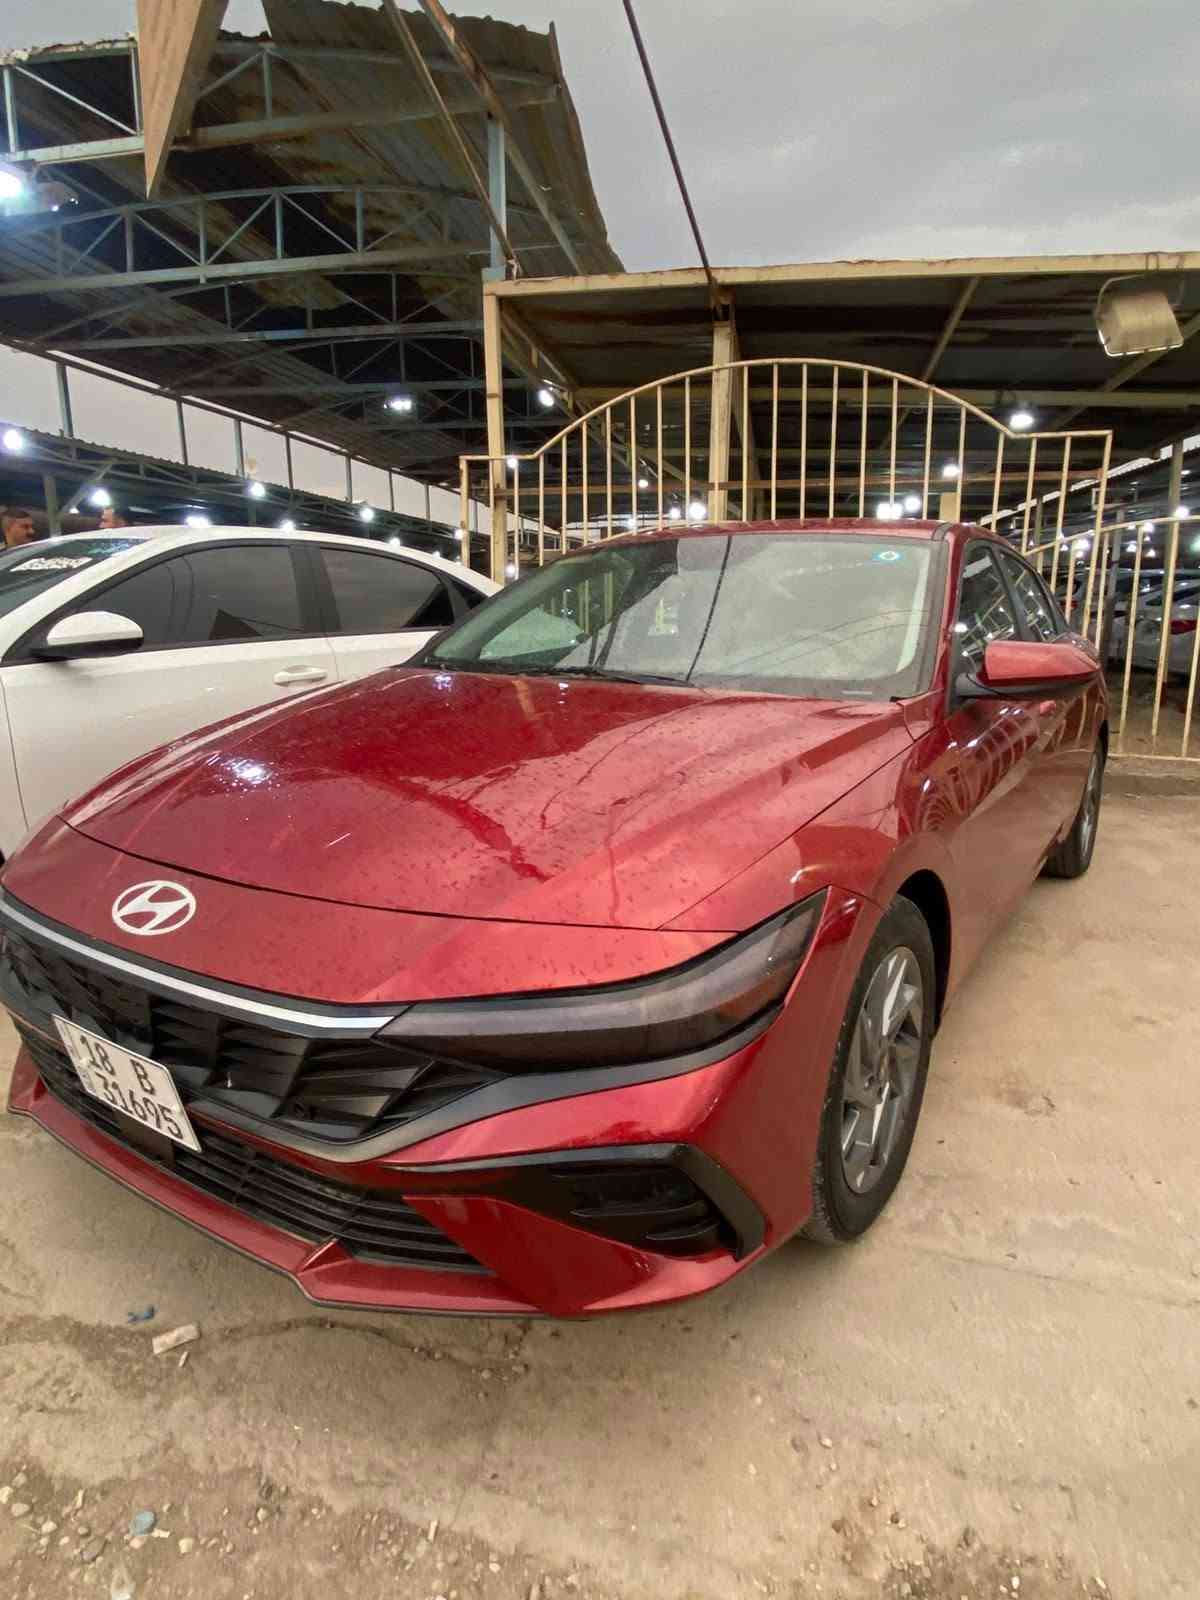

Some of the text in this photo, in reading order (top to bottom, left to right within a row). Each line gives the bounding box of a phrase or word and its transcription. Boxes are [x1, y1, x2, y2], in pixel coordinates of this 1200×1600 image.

[80, 1035, 116, 1076] 18
[130, 1058, 156, 1095] B
[95, 1071, 183, 1139] 31695
